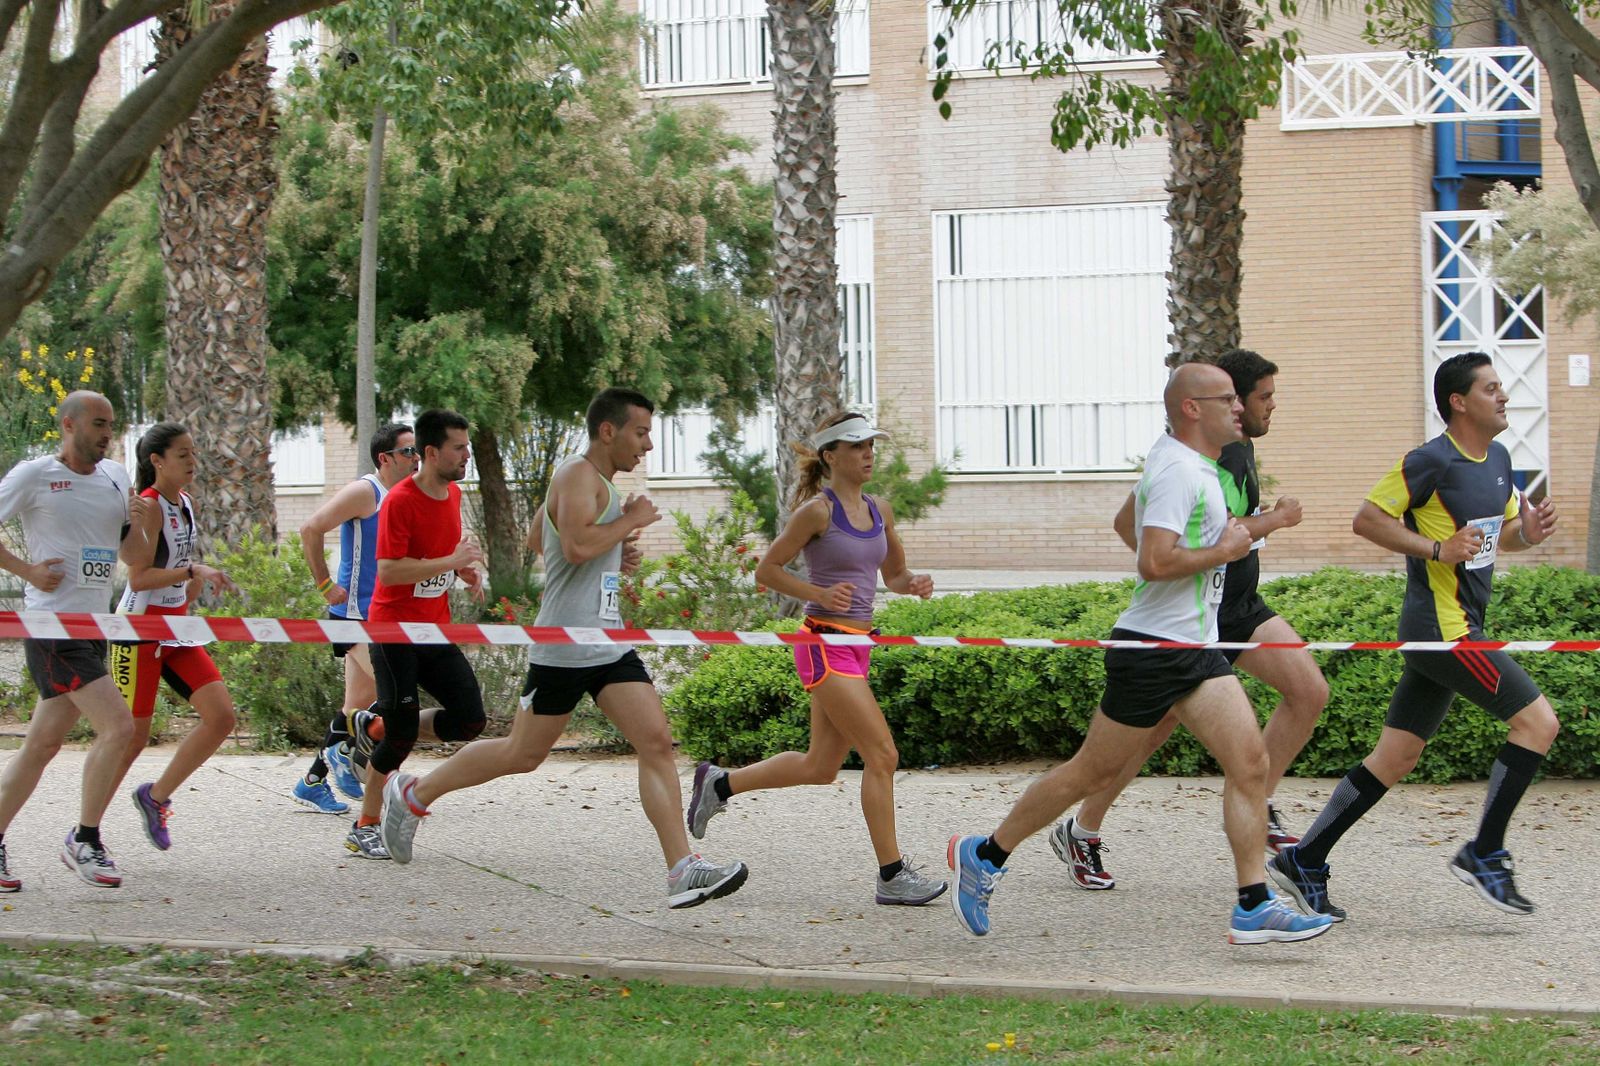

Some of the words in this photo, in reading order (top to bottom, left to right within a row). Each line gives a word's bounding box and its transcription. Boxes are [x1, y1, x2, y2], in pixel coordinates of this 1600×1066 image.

[82, 561, 111, 578] 038
[420, 573, 446, 588] 345
[118, 644, 131, 686] CANO
